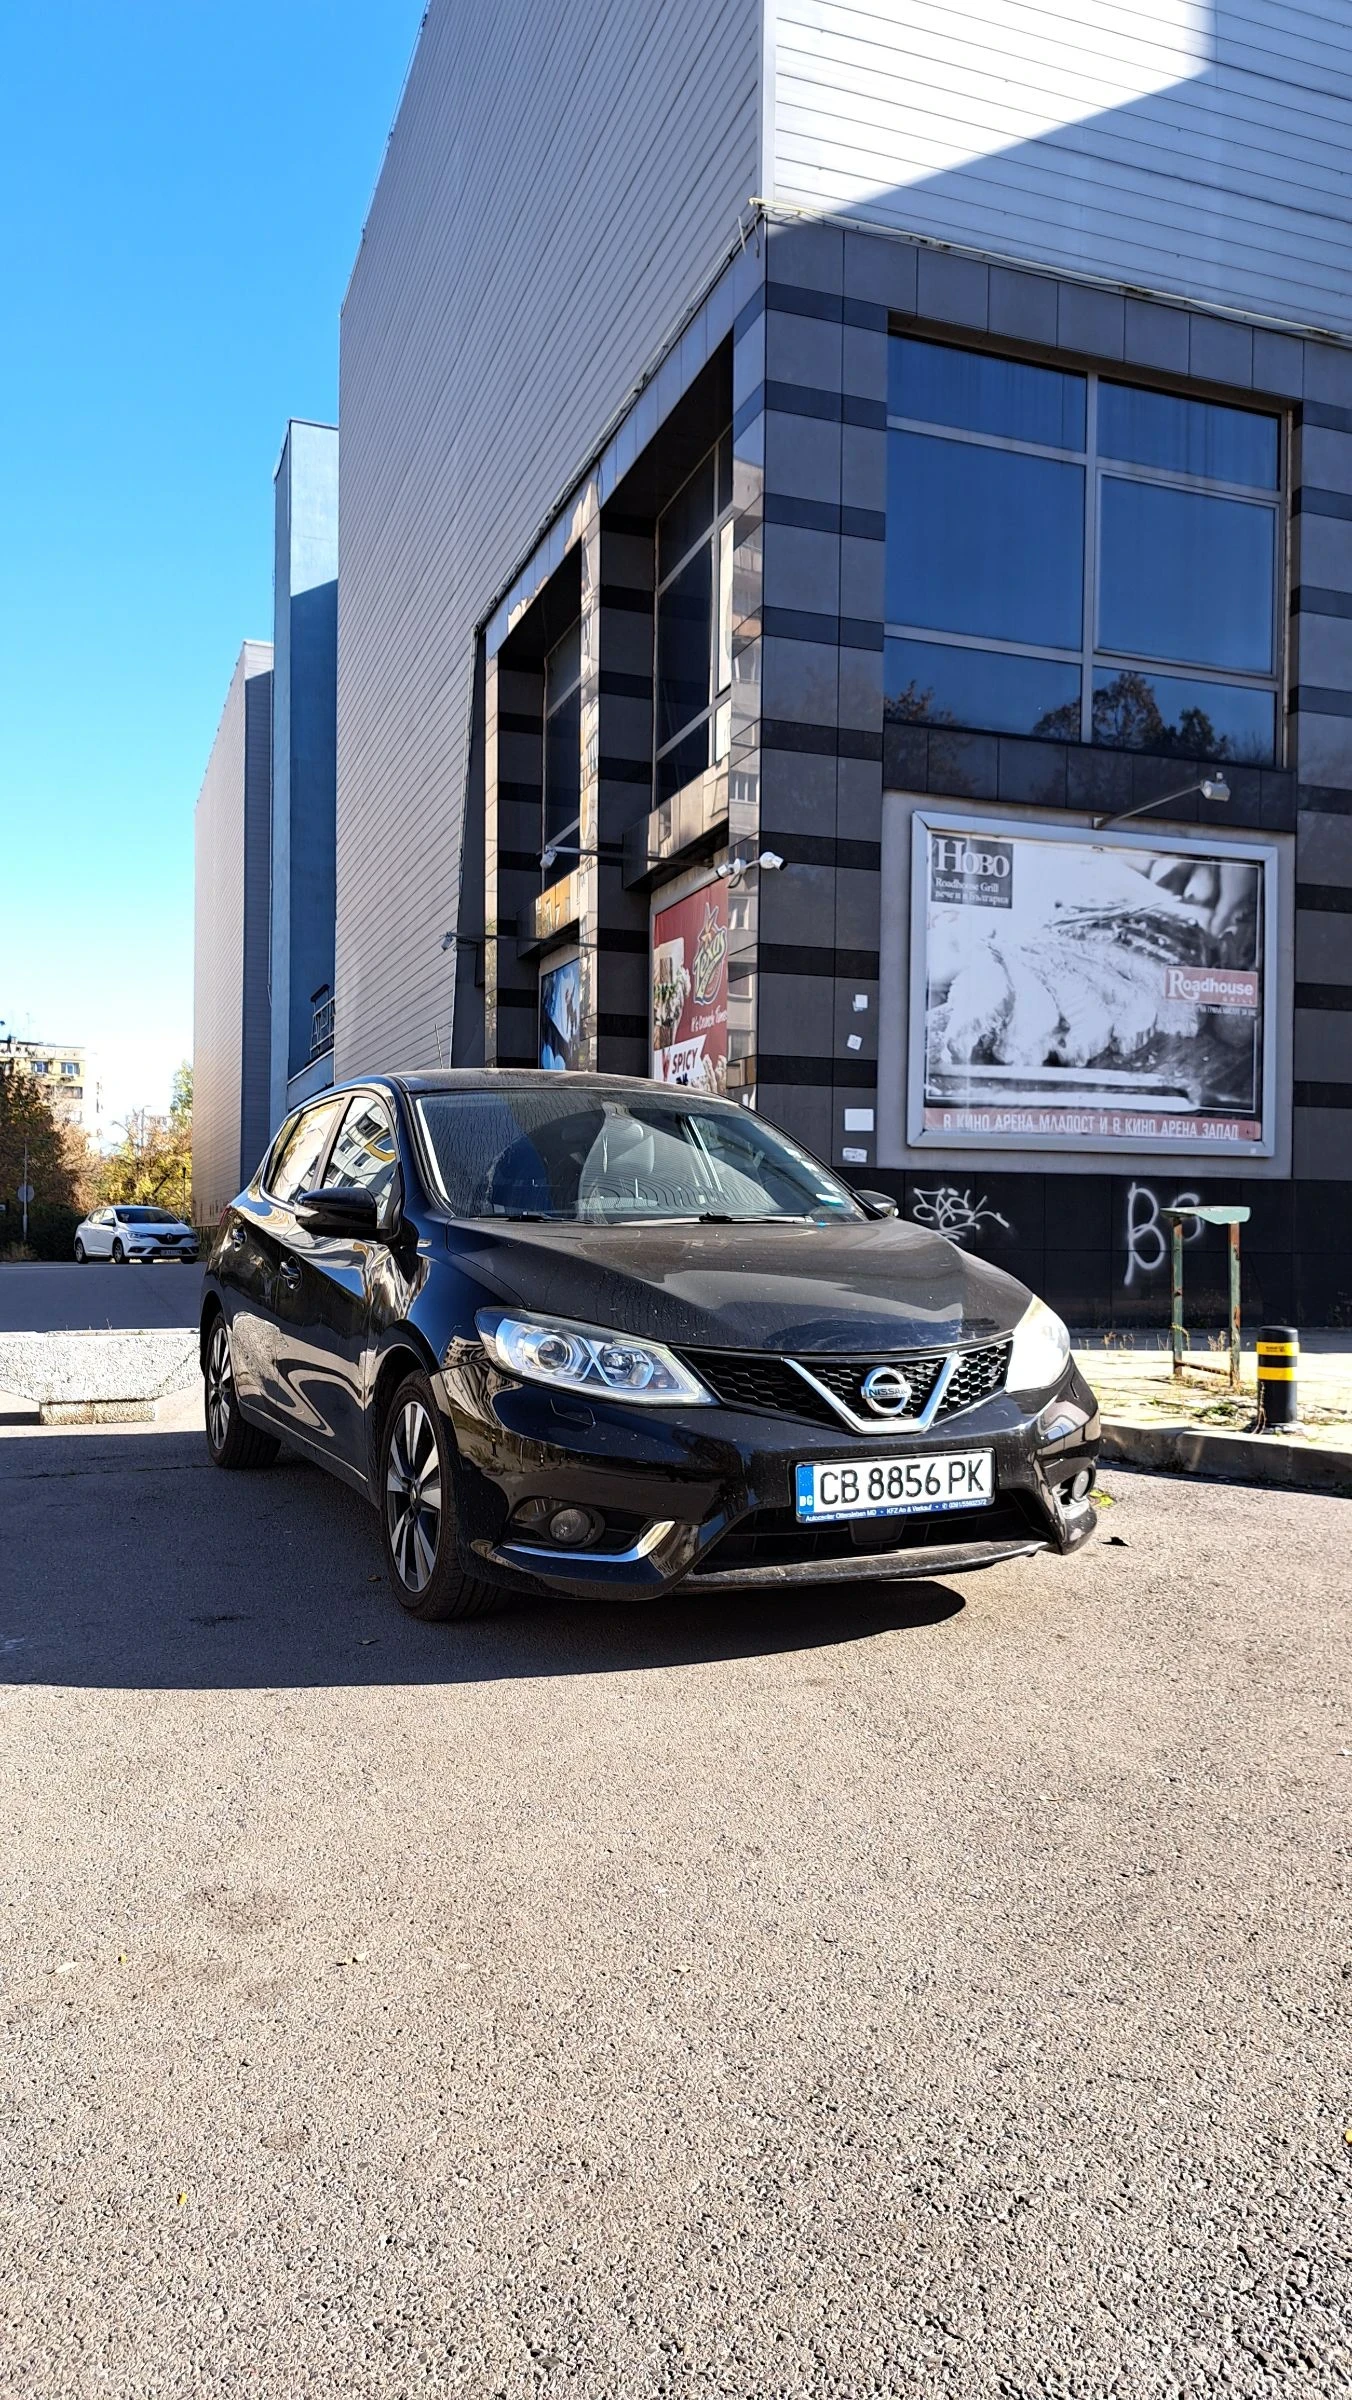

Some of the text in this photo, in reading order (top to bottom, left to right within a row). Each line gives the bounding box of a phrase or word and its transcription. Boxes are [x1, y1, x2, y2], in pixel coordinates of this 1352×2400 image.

[935, 878, 999, 893] Roadhouse Grill
[1167, 969, 1254, 1000] Roadhouse
[672, 1048, 698, 1074] SPICY
[956, 1113, 990, 1131] КИНО
[994, 1113, 1033, 1132] АРЕНА
[1039, 1114, 1095, 1133] МЛАДОСТ
[1100, 1116, 1108, 1134] И
[1125, 1118, 1156, 1136] КИНО
[1160, 1120, 1197, 1138] АРЕНА
[1202, 1122, 1239, 1140] ЗАПАД
[868, 1388, 907, 1398] NISSAN
[820, 1458, 984, 1505] CB 8856 PK
[800, 1495, 813, 1507] BG
